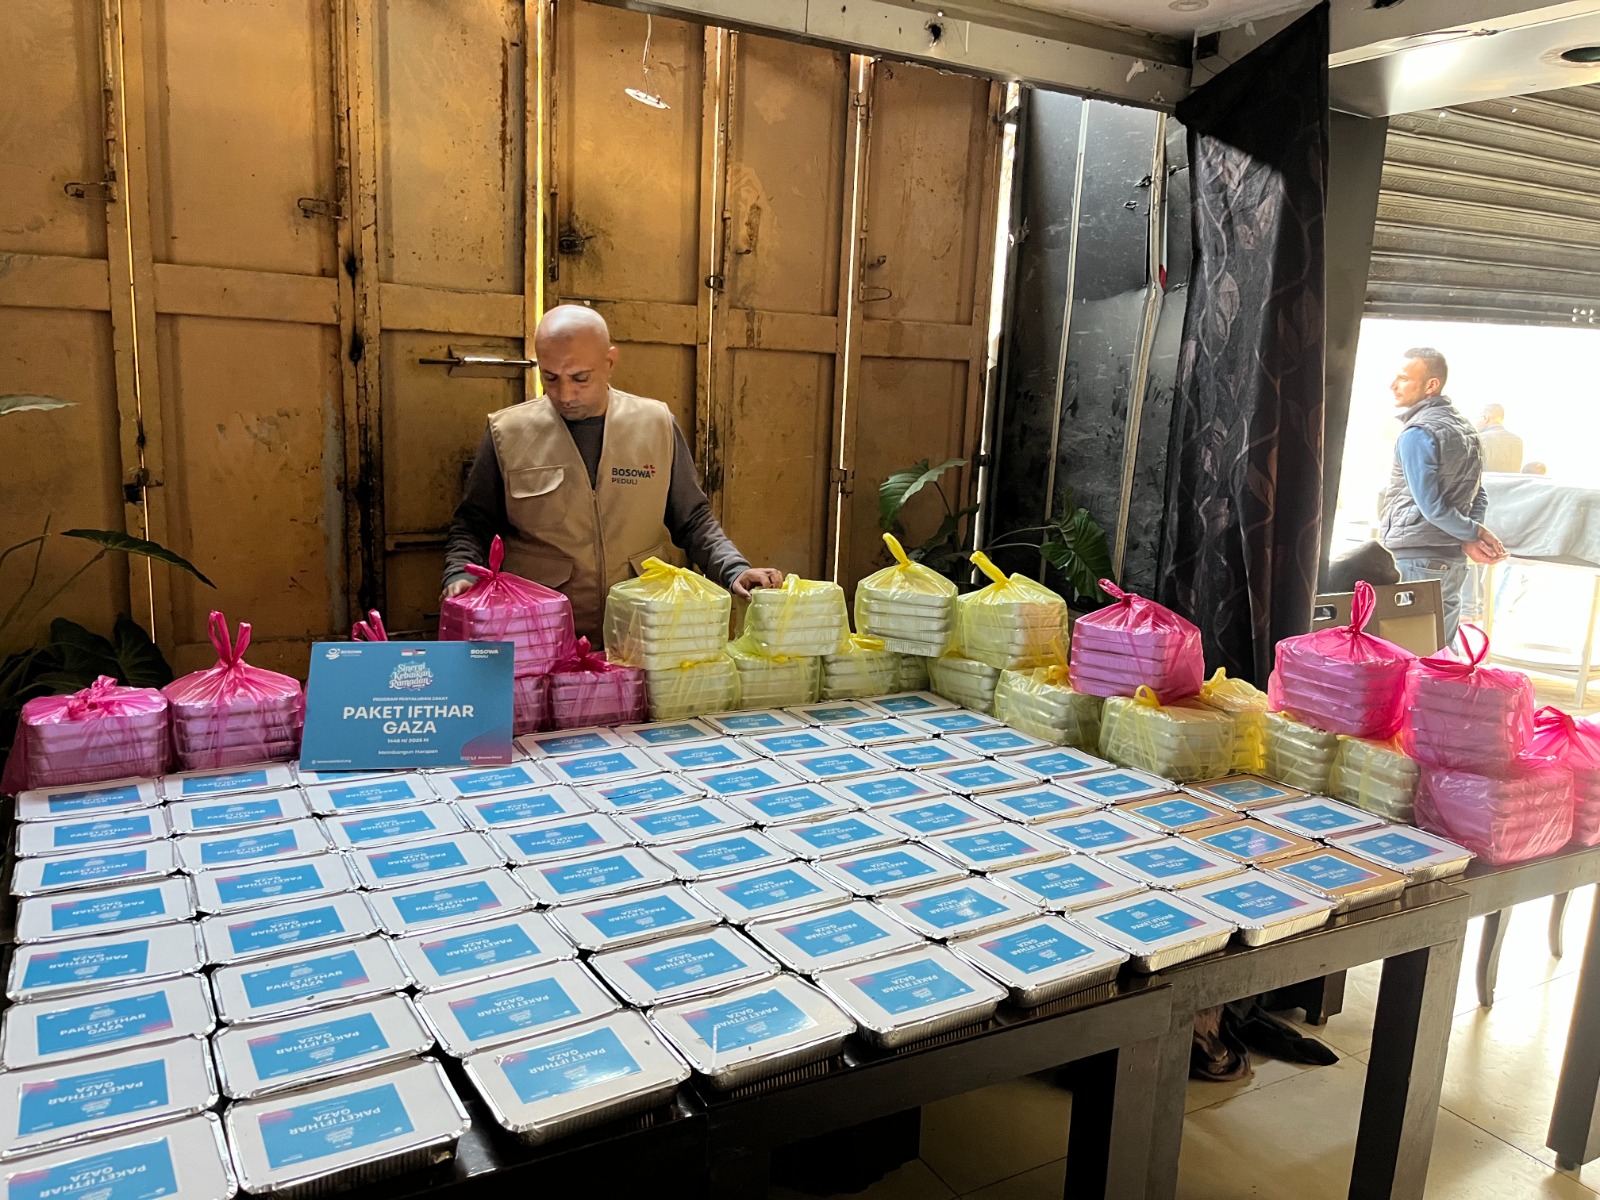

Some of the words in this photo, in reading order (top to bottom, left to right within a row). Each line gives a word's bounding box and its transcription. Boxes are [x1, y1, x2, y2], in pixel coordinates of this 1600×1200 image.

[612, 467, 651, 479] BOSOWA
[611, 477, 638, 485] PEDULI
[398, 662, 426, 673] Sinergi
[391, 670, 433, 681] Kebaikan
[389, 677, 433, 690] Ramadan
[343, 706, 404, 720] PAKET
[407, 704, 474, 718] IFTHAR
[383, 720, 437, 735] GAZA
[561, 870, 592, 879] IFTHAR
[574, 865, 600, 873] GAZA
[592, 865, 619, 873] PAKET
[235, 880, 270, 889] IFTHAR
[252, 875, 281, 883] GAZA
[271, 875, 302, 883] PAKET
[751, 880, 775, 888] GAZA
[768, 879, 794, 888] PAKET
[741, 885, 770, 895] IFTHAR
[414, 902, 445, 911] PAKET
[445, 896, 479, 906] IFTHAR
[435, 902, 464, 911] GAZA
[618, 906, 645, 915] GAZA
[637, 906, 666, 915] PAKET
[288, 918, 321, 928] PAKET
[606, 912, 639, 922] IFTHAR
[268, 919, 299, 929] GAZA
[812, 923, 837, 932] GAZA
[830, 922, 858, 932] PAKET
[249, 925, 287, 936] IFTHAR
[802, 929, 833, 940] IFTHAR
[460, 938, 490, 948] GAZA
[480, 937, 513, 948] PAKET
[1014, 937, 1038, 947] GAZA
[1032, 937, 1058, 947] PAKET
[444, 944, 481, 956] IFTHAR
[1008, 943, 1037, 955] IFTHAR
[71, 952, 104, 961] GAZA
[91, 953, 128, 962] PAKET
[664, 952, 693, 963] GAZA
[684, 951, 715, 962] PAKET
[48, 958, 89, 968] IFTHAR
[651, 958, 686, 971] IFTHAR
[265, 979, 302, 991] PAKET
[303, 970, 343, 983] IFTHAR
[290, 978, 324, 990] GAZA
[889, 974, 917, 985] GAZA
[909, 973, 939, 985] PAKET
[879, 981, 912, 993] IFTHAR
[492, 994, 525, 1007] GAZA
[514, 994, 549, 1007] PAKET
[475, 1002, 515, 1017] IFTHAR
[724, 1006, 755, 1019] GAZA
[746, 1005, 778, 1018] PAKET
[59, 1022, 100, 1036] PAKET
[102, 1013, 146, 1027] IFTHAR
[710, 1014, 748, 1029] IFTHAR
[87, 1022, 124, 1035] GAZA
[296, 1031, 333, 1044] GAZA
[320, 1030, 359, 1044] PAKET
[274, 1039, 319, 1055] IFTHAR
[545, 1048, 580, 1062] GAZA
[569, 1046, 605, 1061] PAKET
[527, 1057, 569, 1073] IFTHAR
[74, 1080, 114, 1093] GAZA
[100, 1080, 143, 1094] PAKET
[47, 1089, 97, 1105] IFTHAR
[311, 1106, 351, 1122] GAZA
[338, 1106, 381, 1122] PAKET
[287, 1116, 337, 1135] IFTHAR
[70, 1163, 114, 1181] GAZA
[99, 1163, 147, 1182] PAKET
[40, 1175, 95, 1196] IFTHAR
